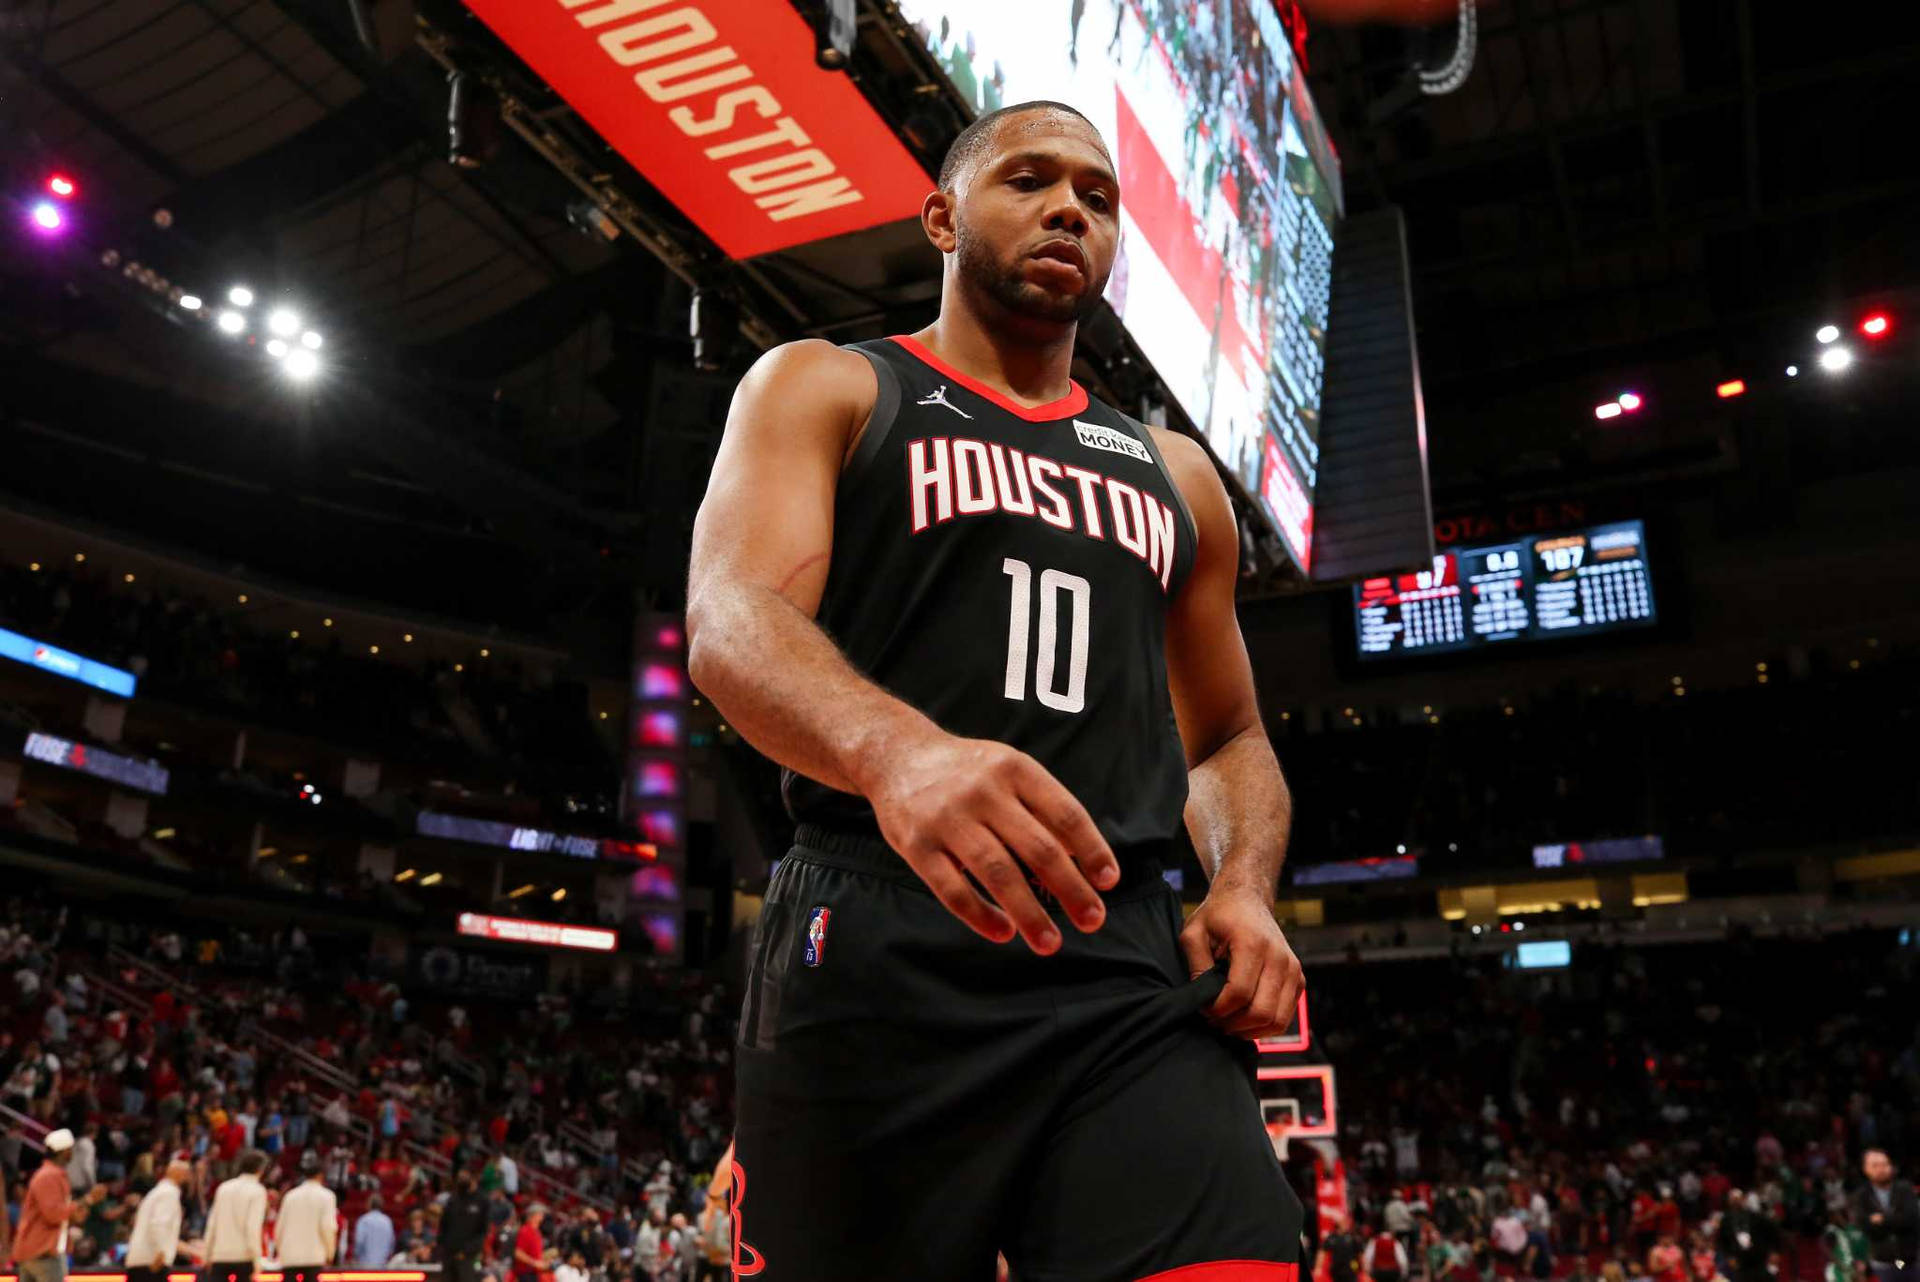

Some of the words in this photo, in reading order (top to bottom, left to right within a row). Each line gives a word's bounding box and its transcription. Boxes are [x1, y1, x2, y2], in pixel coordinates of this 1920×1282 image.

[1080, 432, 1146, 459] MONEY
[907, 437, 1177, 594] HOUSTON
[1434, 513, 1494, 544] OTA
[1002, 557, 1091, 714] 10
